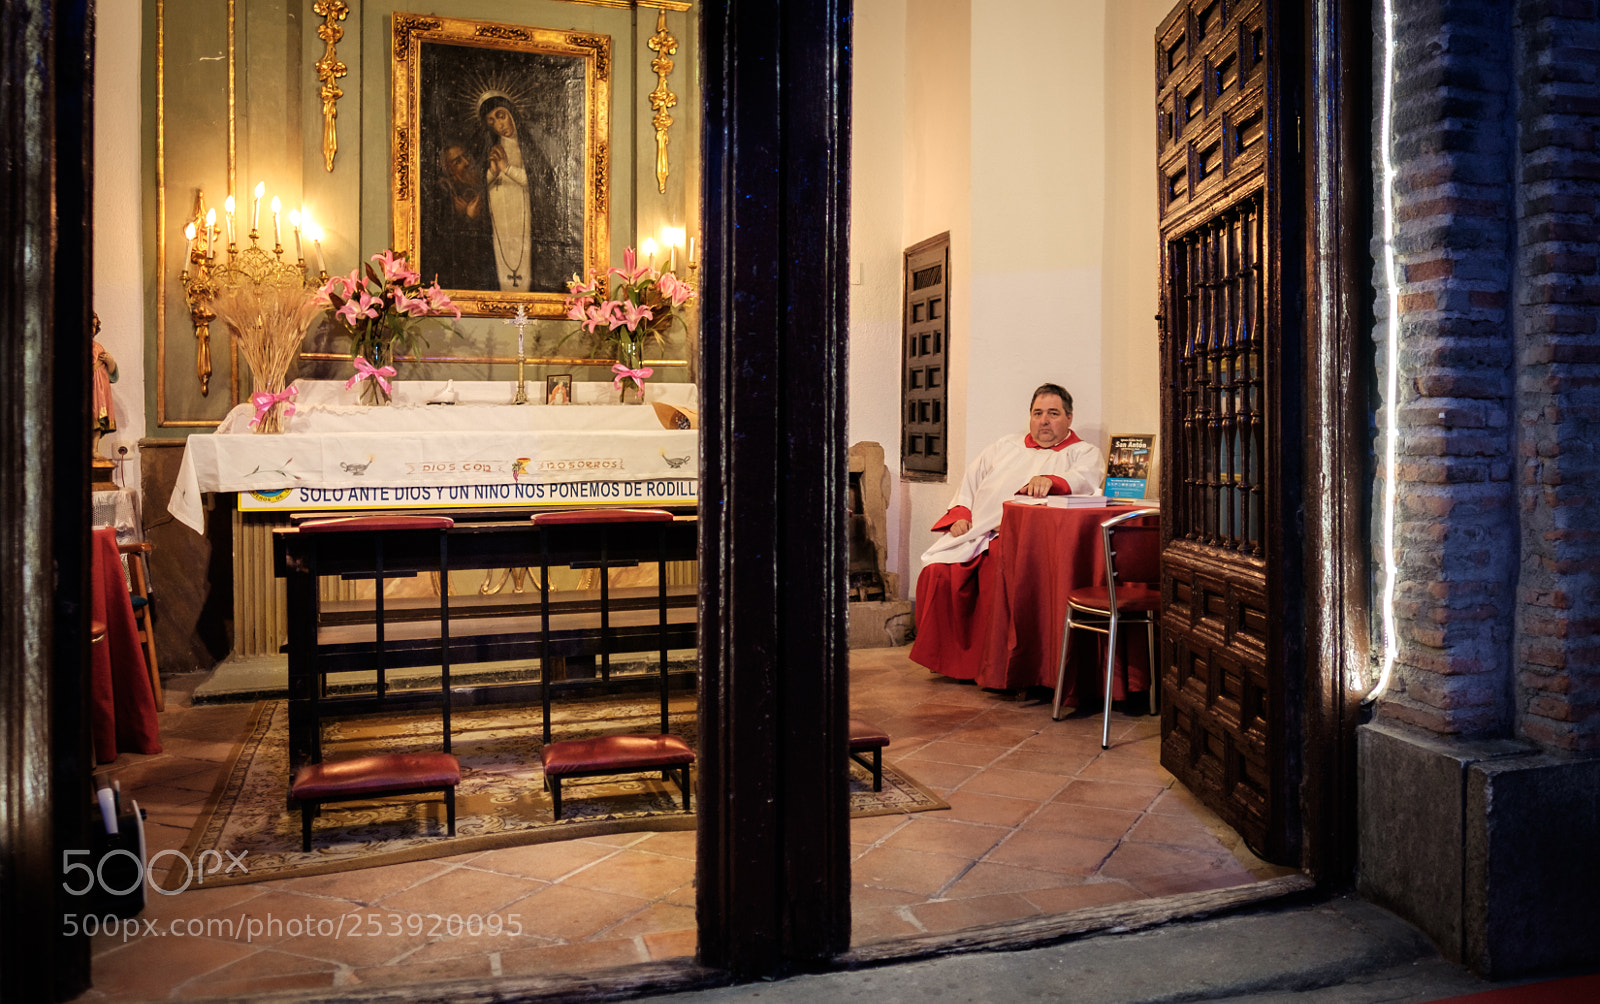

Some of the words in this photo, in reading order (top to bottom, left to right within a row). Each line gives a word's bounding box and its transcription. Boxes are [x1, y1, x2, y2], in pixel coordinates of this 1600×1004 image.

[422, 463, 456, 472] DIOS
[300, 487, 344, 502] SOLO
[348, 487, 389, 502] ANTE
[395, 487, 431, 501] DIOS
[436, 486, 444, 500] Y
[449, 485, 469, 500] UN
[515, 483, 545, 499] NOS
[550, 481, 620, 498] PONEMOS
[624, 481, 642, 497] DE
[647, 481, 698, 497] RODILL
